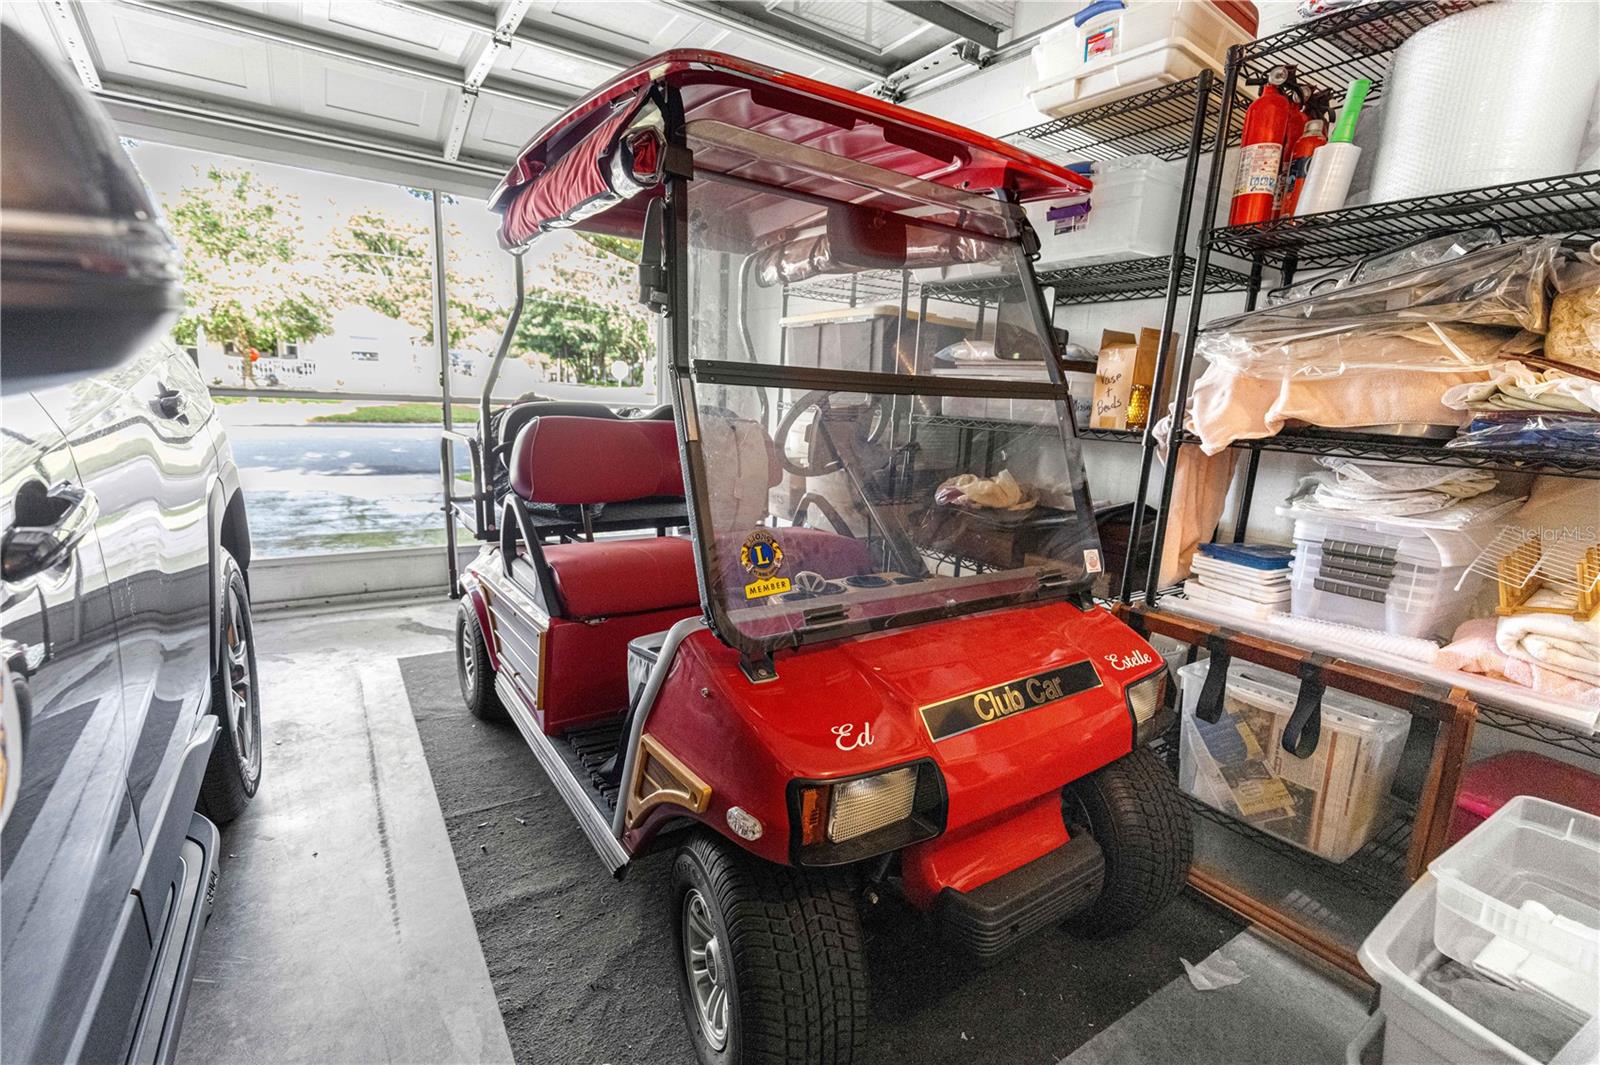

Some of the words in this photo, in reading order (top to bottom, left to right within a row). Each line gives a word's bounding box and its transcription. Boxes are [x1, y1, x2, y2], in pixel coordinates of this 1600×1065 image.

[1100, 368, 1122, 385] Vase
[1097, 395, 1122, 415] Beads
[754, 545, 769, 565] L
[749, 581, 786, 595] MEMBER
[1104, 650, 1152, 671] Estelle
[973, 686, 1025, 721] Club
[1026, 676, 1063, 704] Car
[831, 722, 874, 751] Ed
